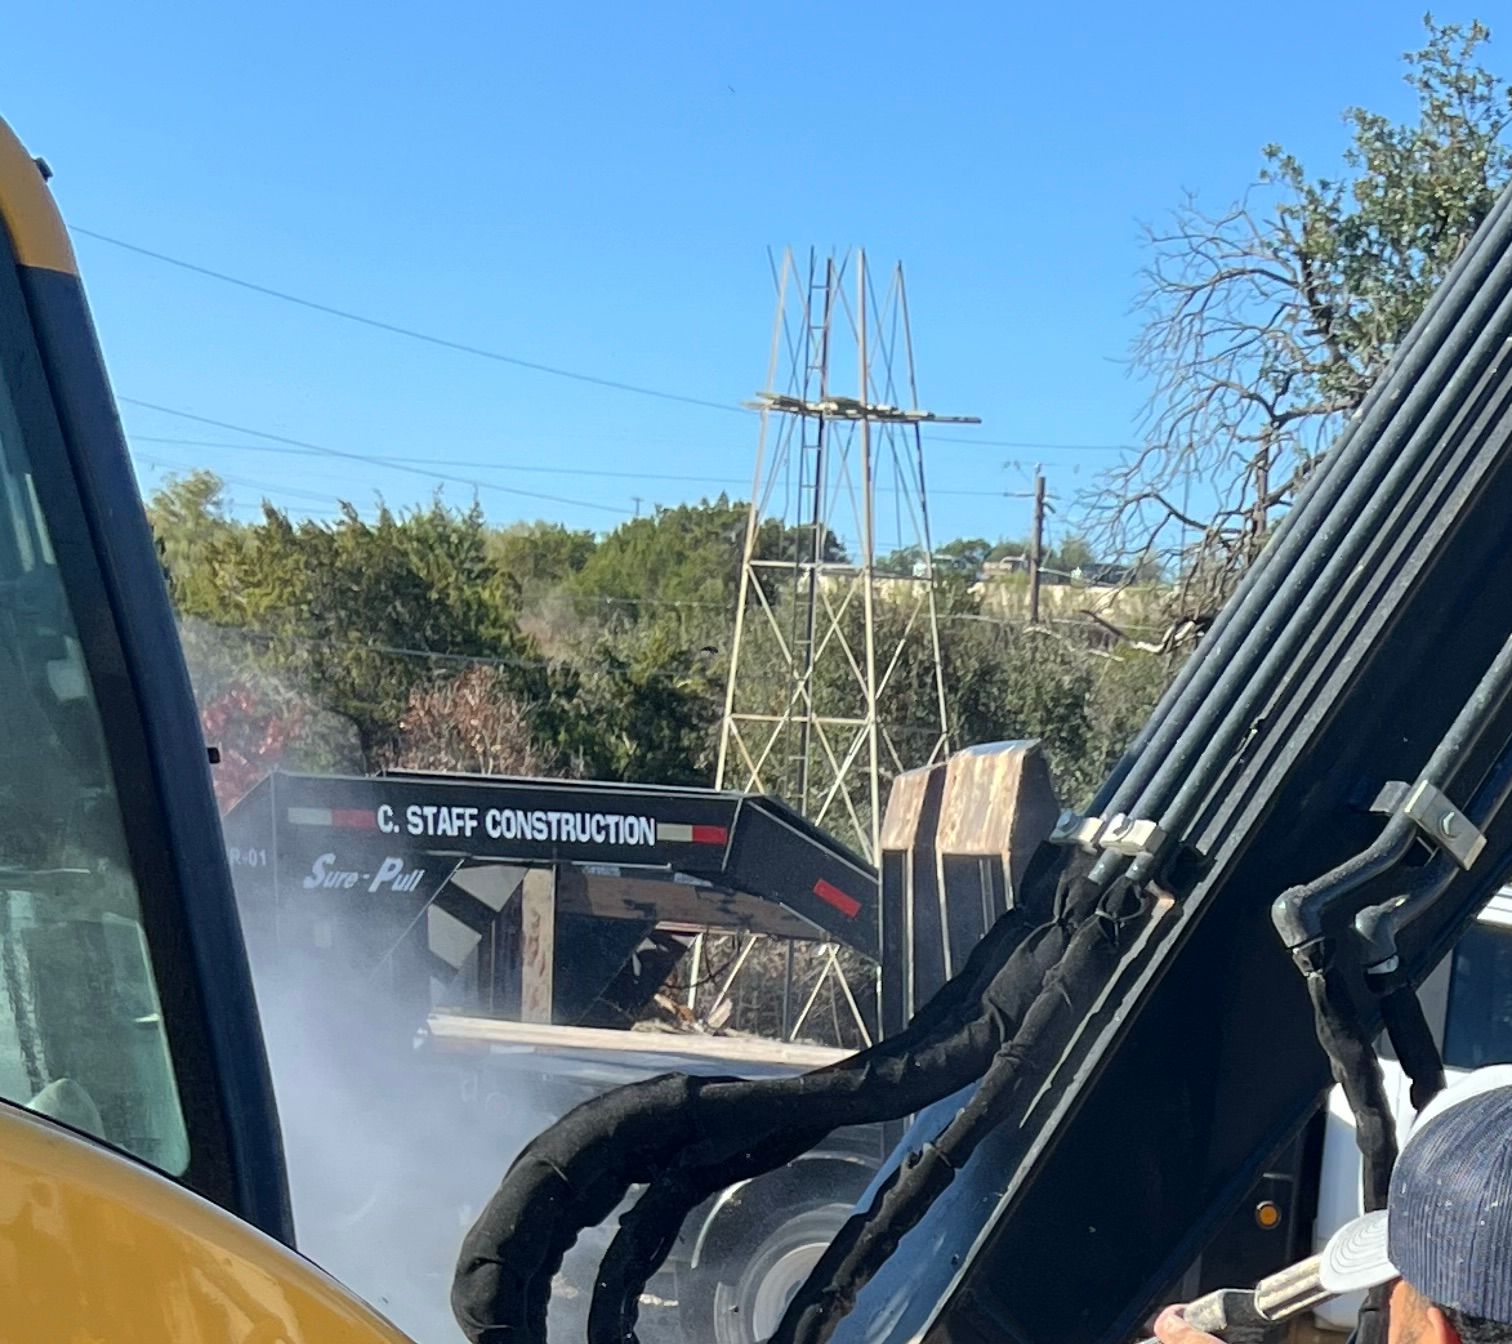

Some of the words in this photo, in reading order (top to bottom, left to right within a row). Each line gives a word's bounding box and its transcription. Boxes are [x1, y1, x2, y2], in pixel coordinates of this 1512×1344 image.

[377, 804, 399, 833] C.
[406, 804, 478, 837] STAFF
[485, 808, 656, 846] CONSTRUCTION
